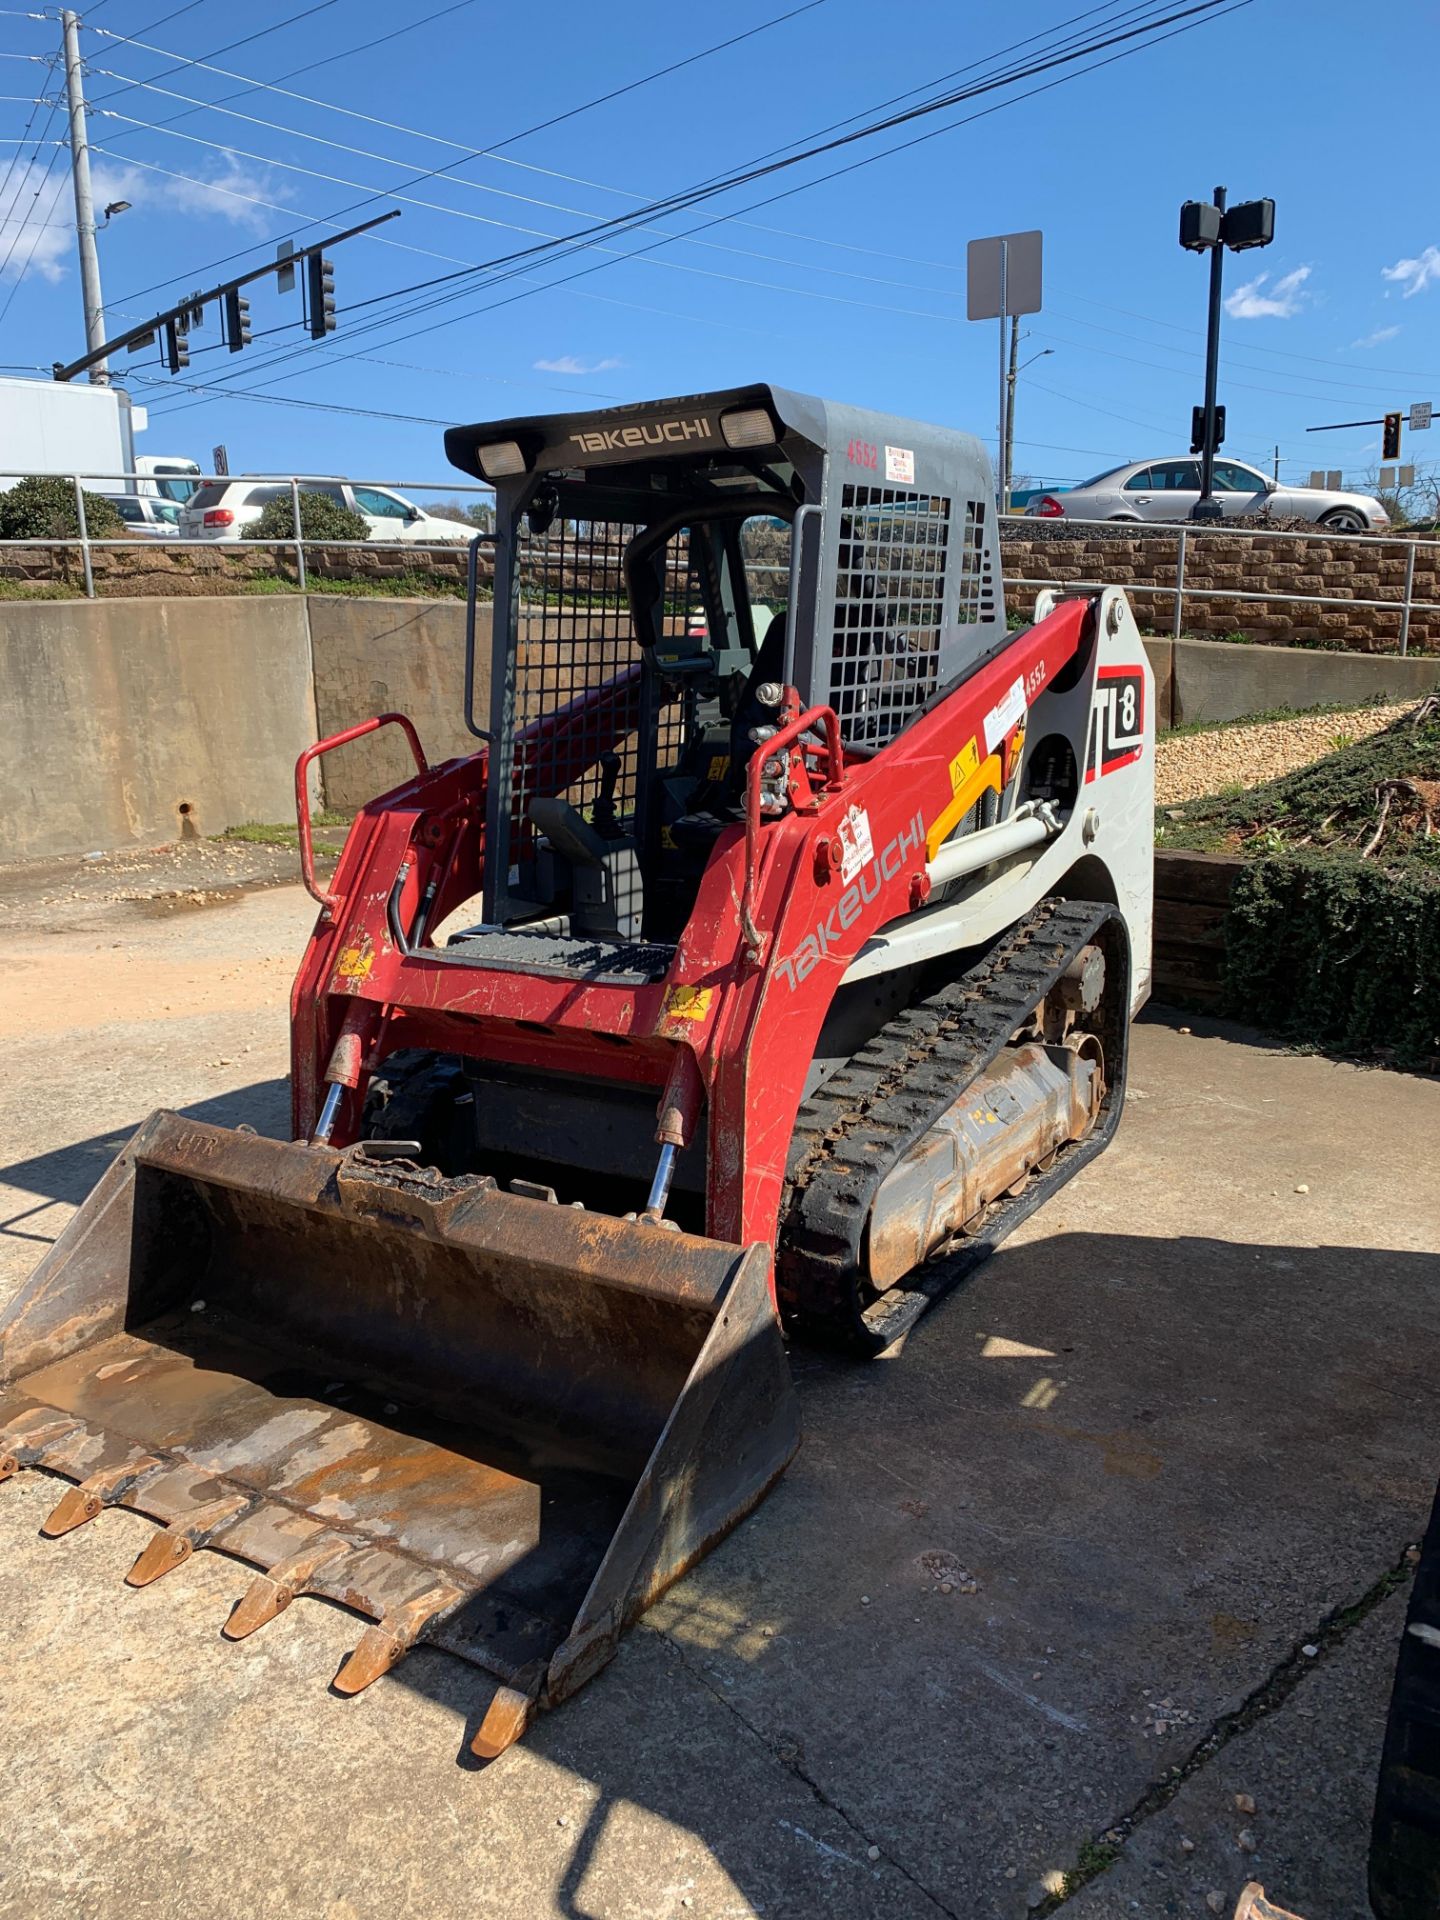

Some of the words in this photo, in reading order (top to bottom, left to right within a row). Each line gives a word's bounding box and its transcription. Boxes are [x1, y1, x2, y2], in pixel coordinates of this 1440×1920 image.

[569, 417, 712, 453] TAKEUCHI
[1025, 659, 1046, 698] 4552
[774, 809, 926, 992] TAKEUCHI
